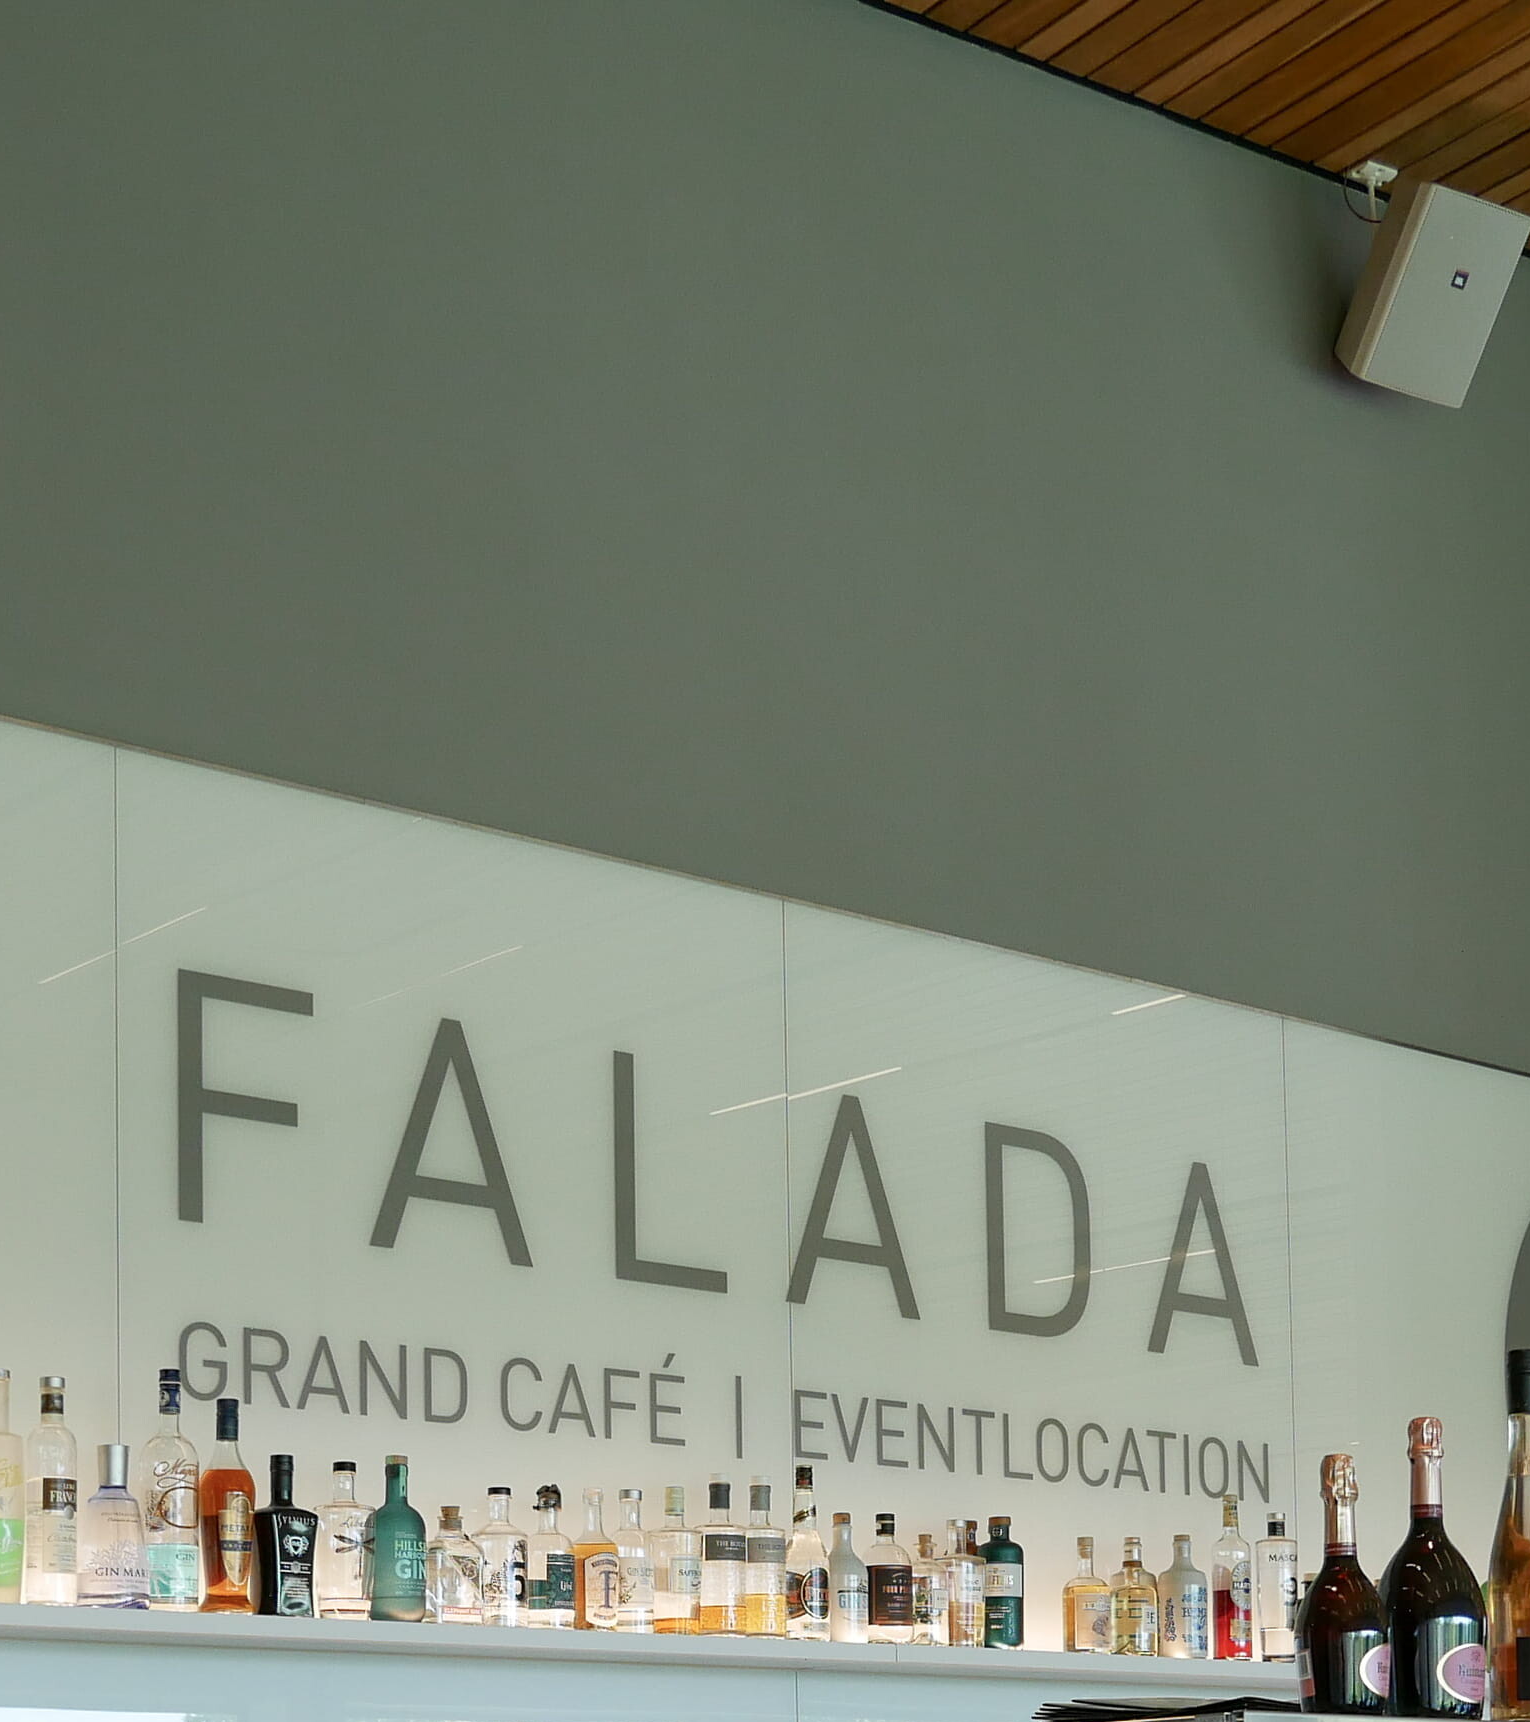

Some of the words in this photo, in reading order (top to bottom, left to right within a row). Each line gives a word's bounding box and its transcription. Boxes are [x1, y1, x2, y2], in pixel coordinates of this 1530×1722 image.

[177, 968, 1259, 1367] FALADA
[178, 1320, 468, 1425] GRAND
[498, 1352, 687, 1448] CAFÉ
[792, 1388, 1273, 1504] EVENTLOCATION
[277, 1514, 316, 1528] SYLVIUS
[95, 1567, 120, 1577] GIN
